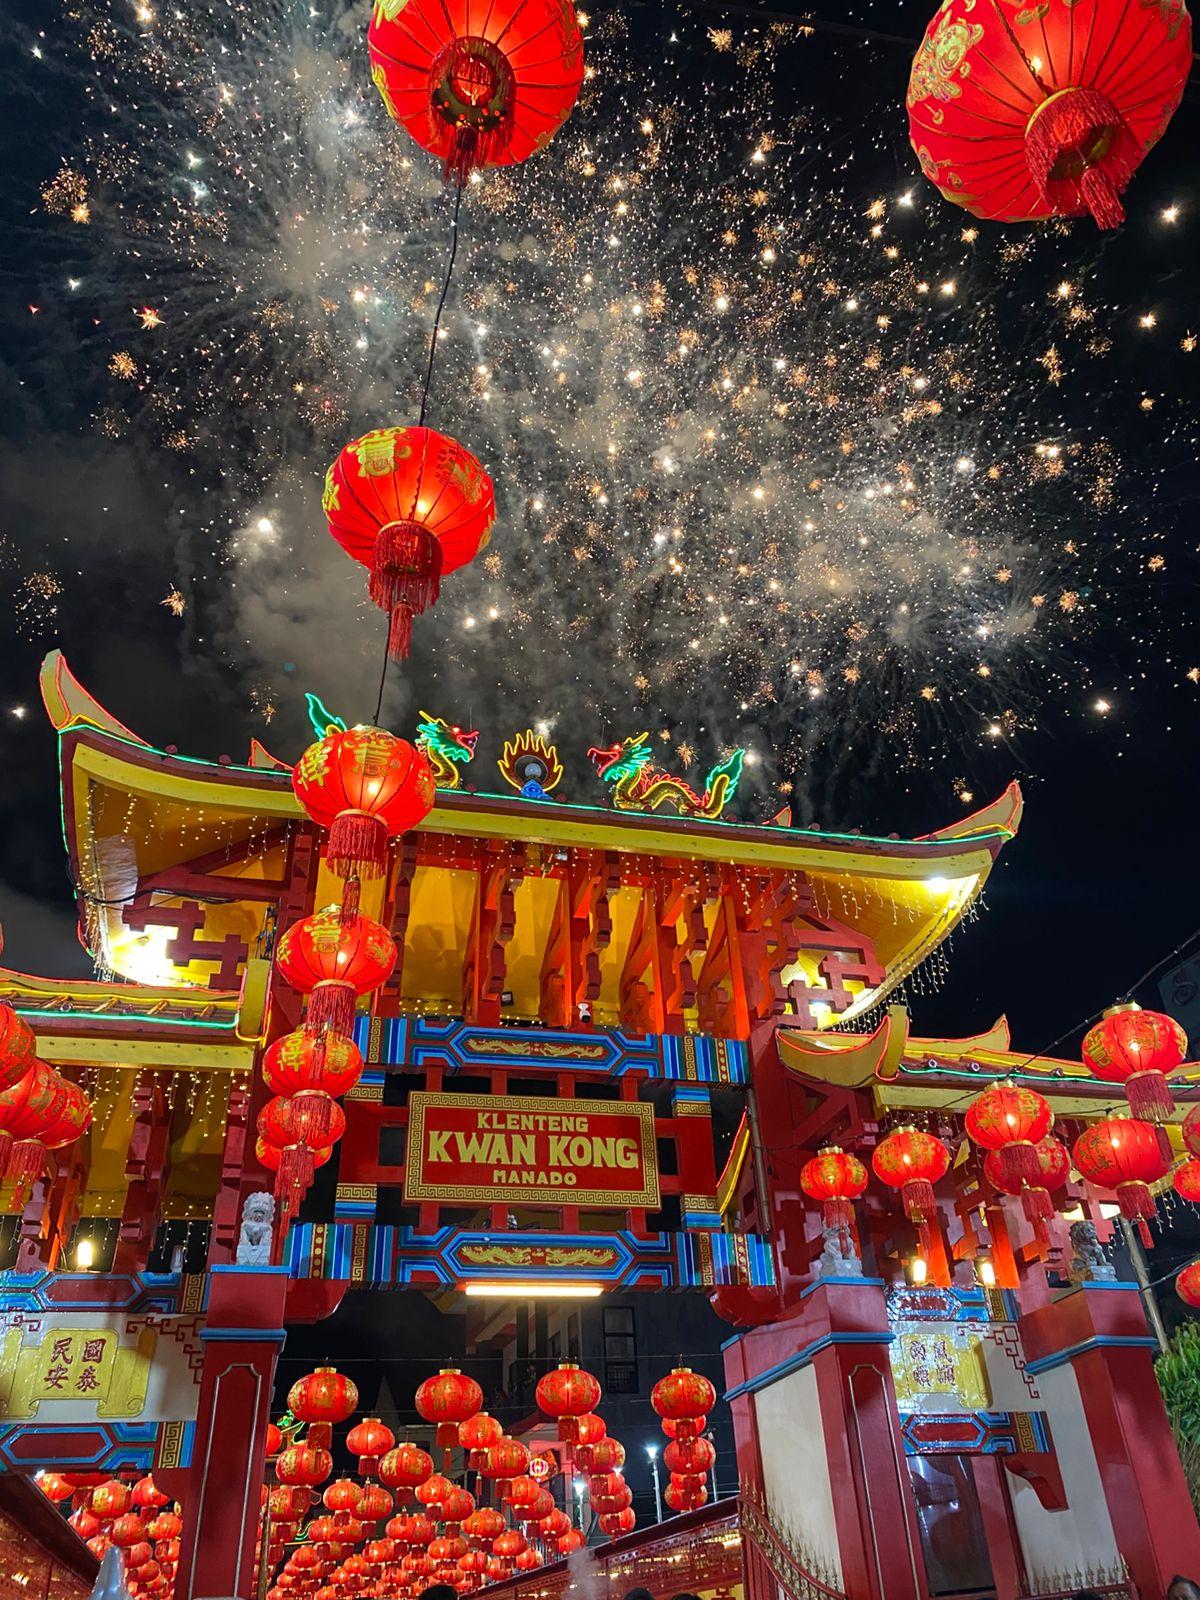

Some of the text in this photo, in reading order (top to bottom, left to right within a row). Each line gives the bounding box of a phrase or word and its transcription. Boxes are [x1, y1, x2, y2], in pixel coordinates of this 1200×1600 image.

[477, 1113, 588, 1132] KLENTENG
[427, 1130, 639, 1169] KWAN KONG
[493, 1170, 577, 1186] MANADO
